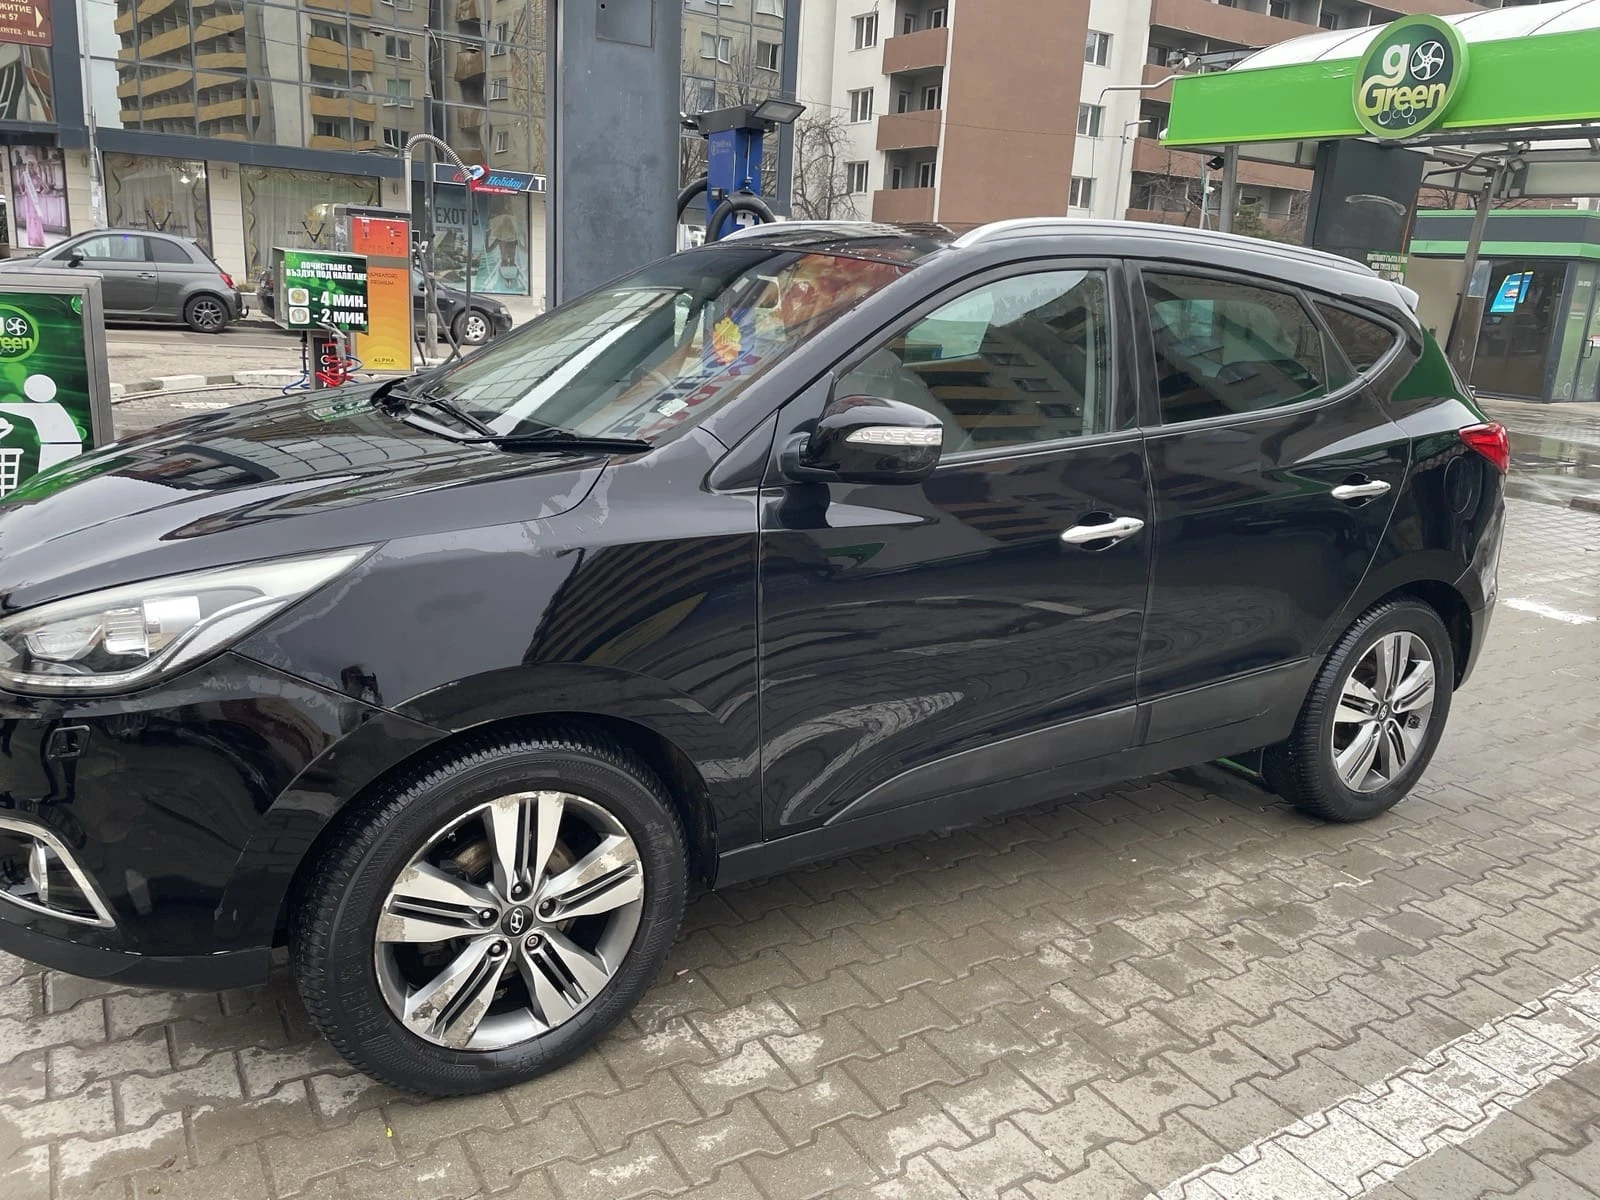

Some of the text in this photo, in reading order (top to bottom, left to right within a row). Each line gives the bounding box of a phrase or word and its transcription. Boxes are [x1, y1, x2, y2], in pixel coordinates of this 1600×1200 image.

[9, 13, 18, 21] 57
[1359, 76, 1446, 117] Green
[487, 175, 522, 190] Holiday
[435, 207, 480, 226] EXOTC
[286, 268, 315, 278] ВЪЗДУХ
[316, 270, 332, 279] ПОД
[332, 293, 367, 308] МИН.
[321, 308, 331, 323] 2
[333, 311, 368, 325] МИН.
